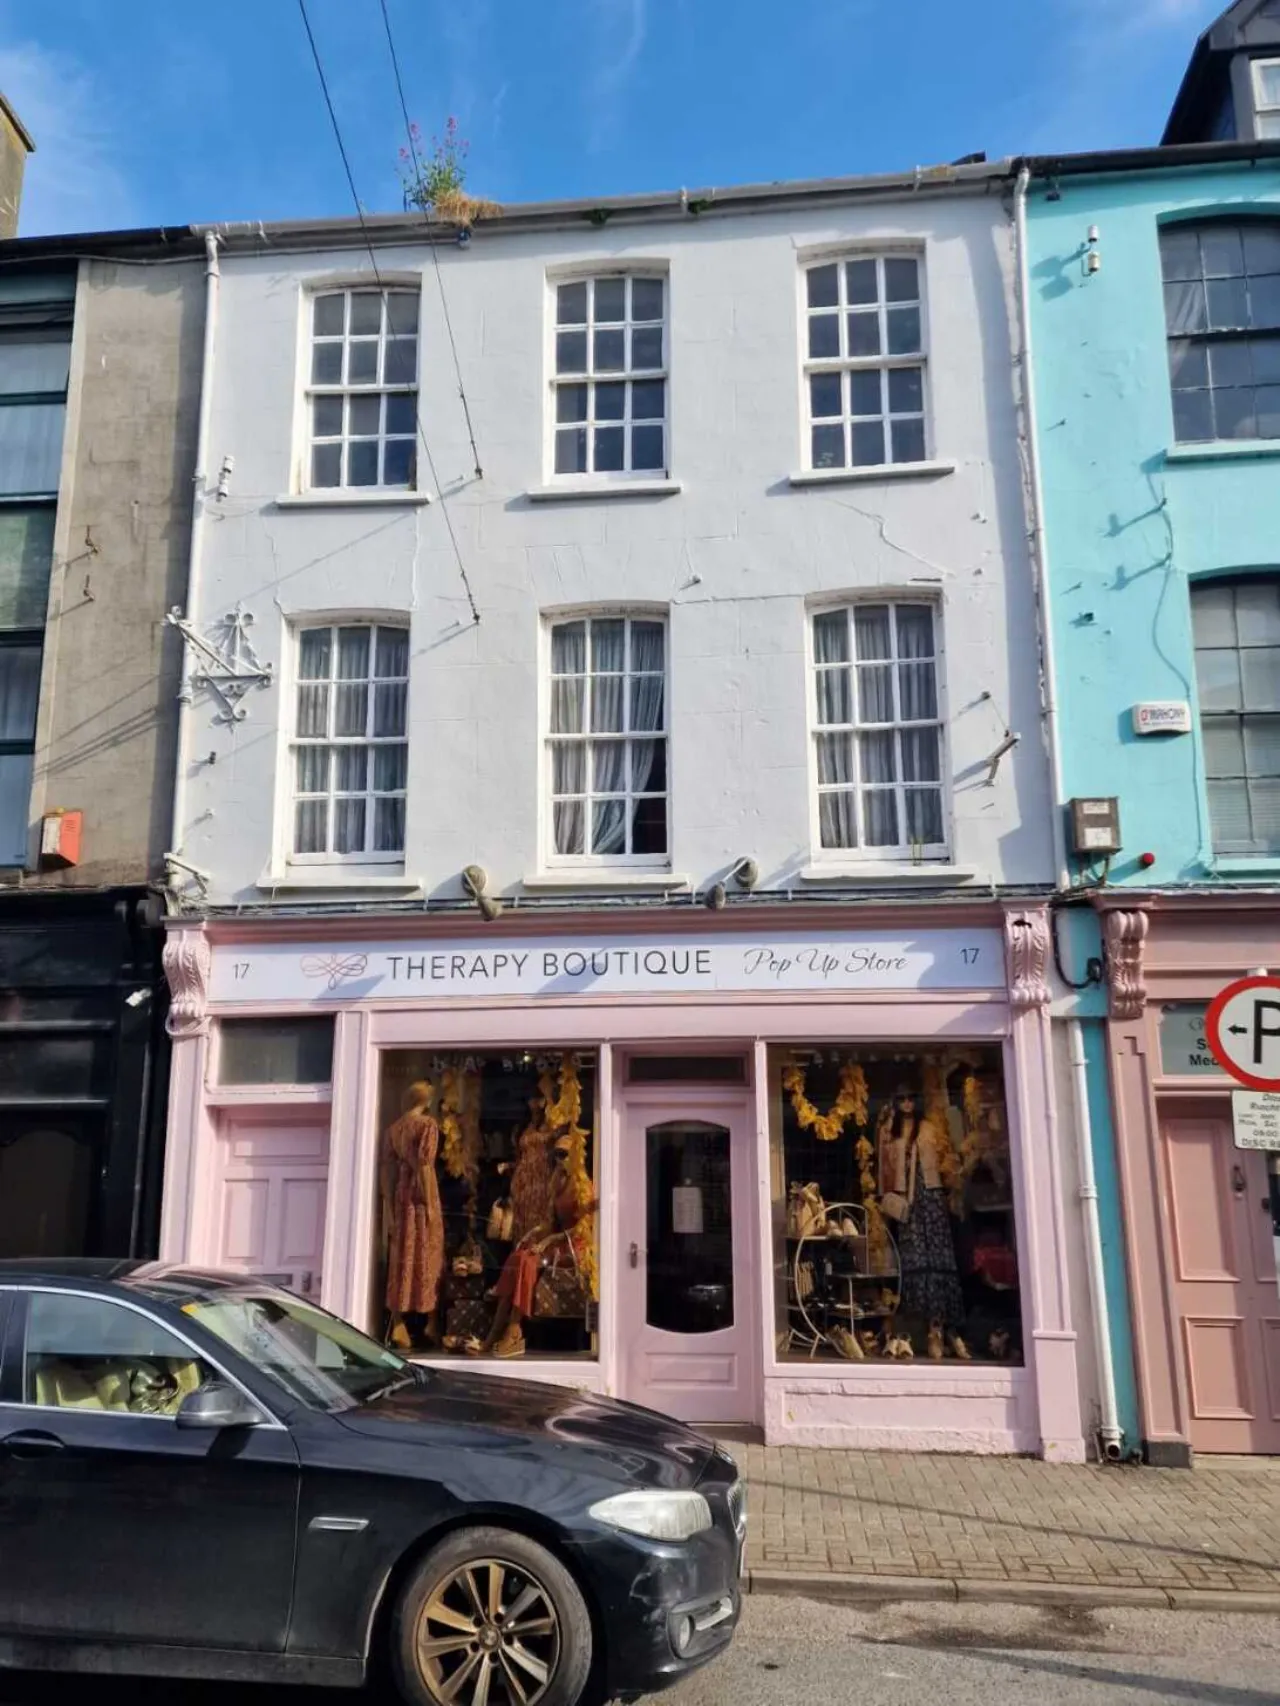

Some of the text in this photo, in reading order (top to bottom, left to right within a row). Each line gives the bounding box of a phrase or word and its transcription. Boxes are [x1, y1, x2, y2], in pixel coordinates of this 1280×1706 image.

[387, 949, 712, 980] THERAPY BOUTIQUE
[743, 947, 908, 979] Pop Up Store
[960, 947, 979, 964] 17
[233, 963, 250, 980] 17
[1254, 999, 1280, 1064] P
